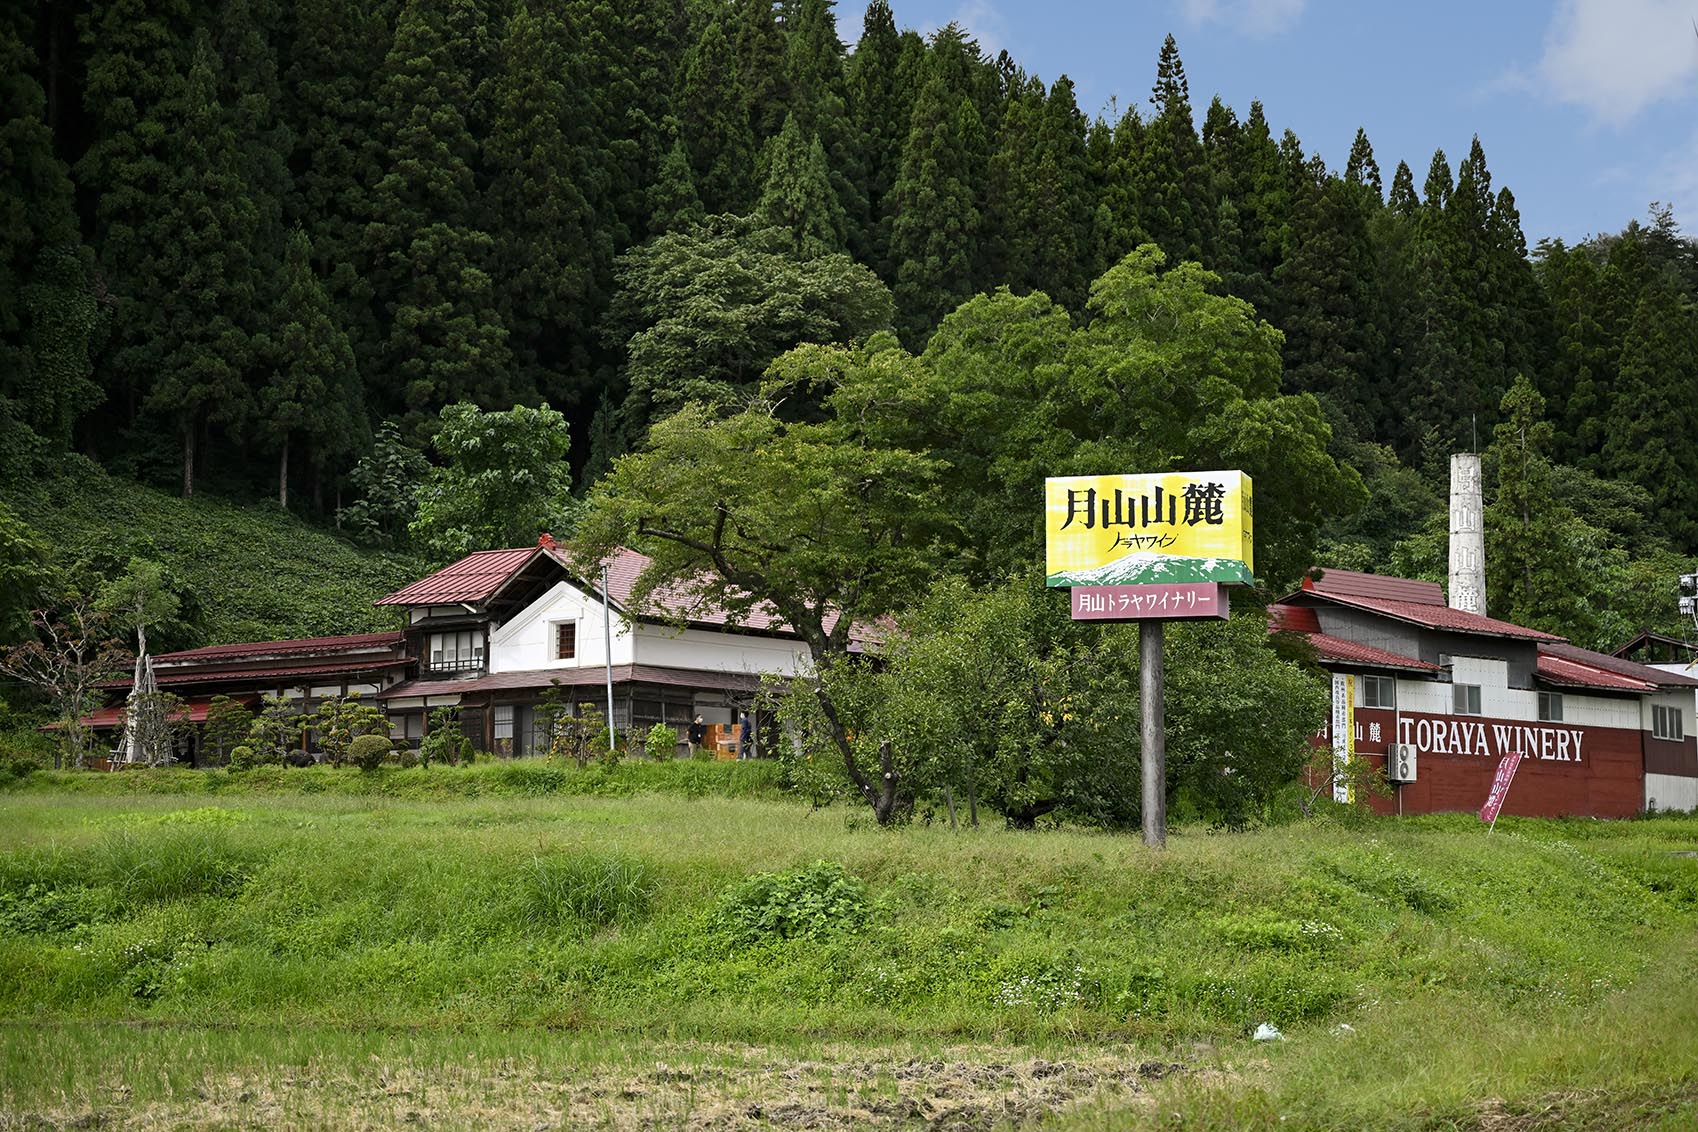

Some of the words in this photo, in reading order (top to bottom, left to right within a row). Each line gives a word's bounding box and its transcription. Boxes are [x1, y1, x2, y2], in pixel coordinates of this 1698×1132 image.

[1060, 482, 1226, 531] 月山山麓
[1107, 531, 1179, 552] トラヤワイン
[1078, 590, 1211, 613] 月山トラヤワイナリー
[1399, 717, 1491, 757] TORAYA
[1492, 723, 1584, 762] WINERY
